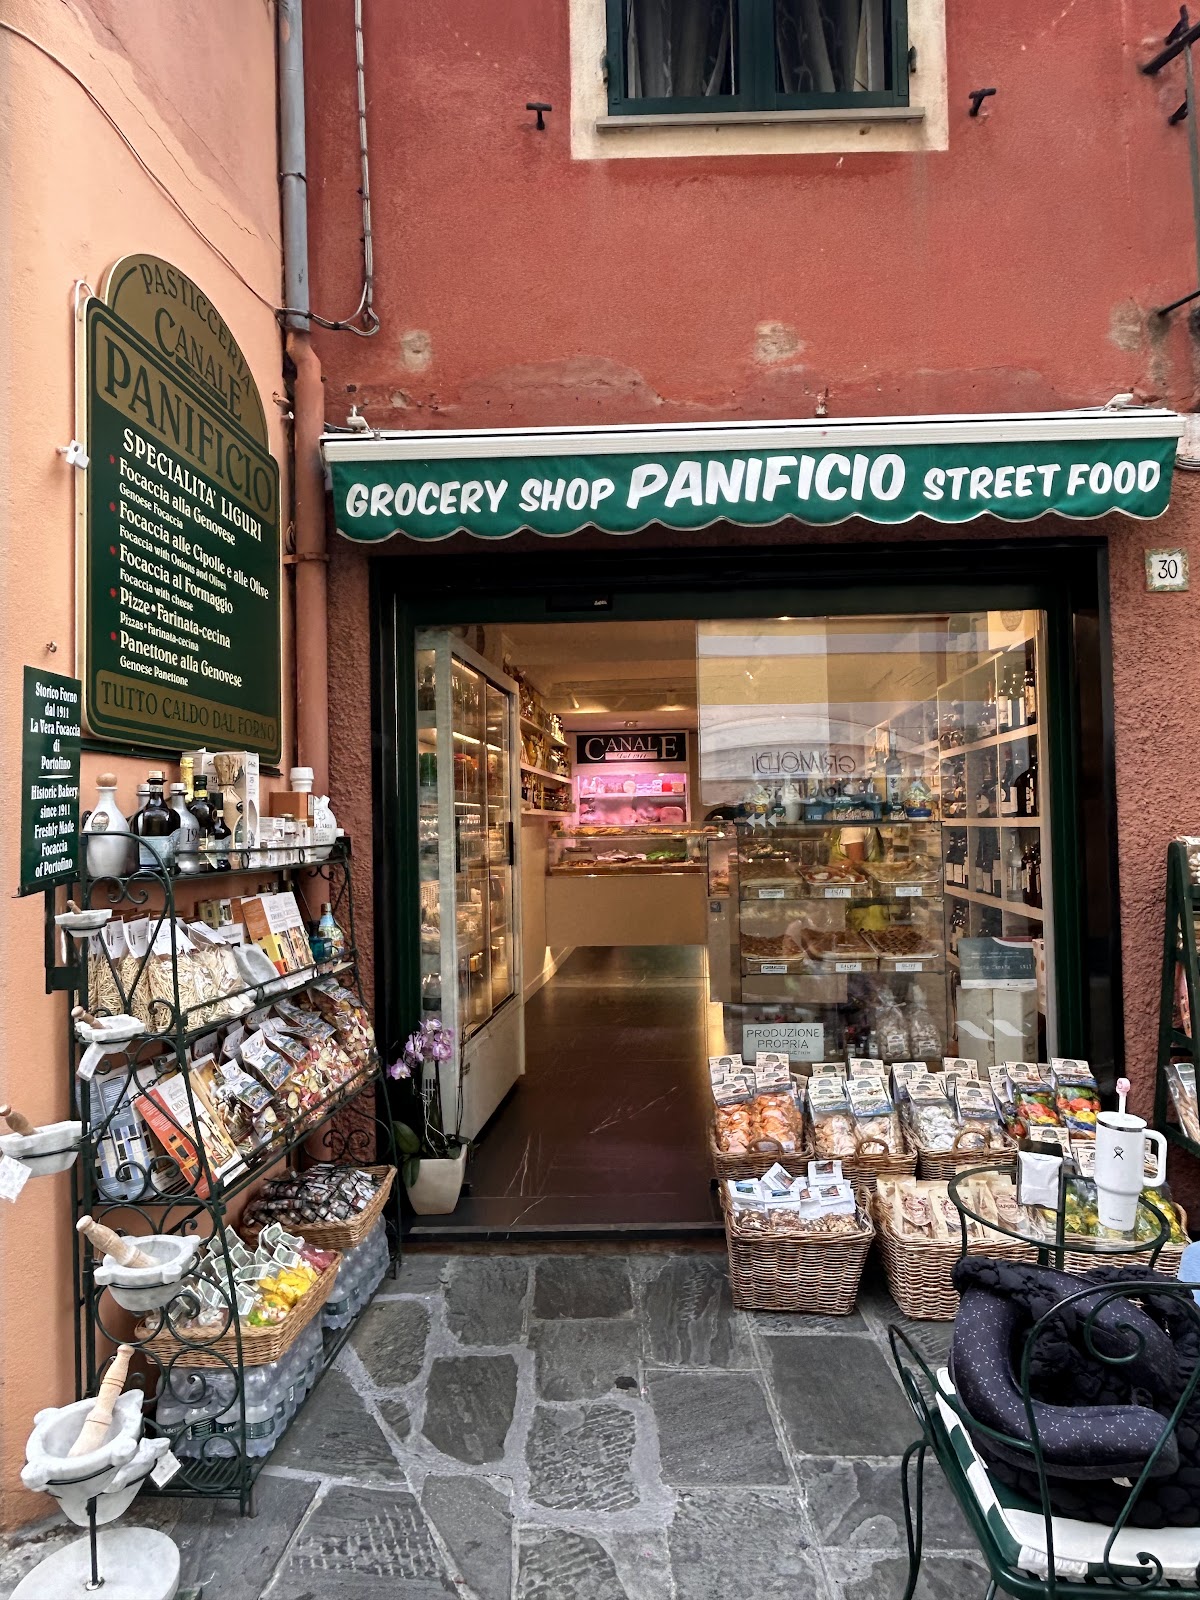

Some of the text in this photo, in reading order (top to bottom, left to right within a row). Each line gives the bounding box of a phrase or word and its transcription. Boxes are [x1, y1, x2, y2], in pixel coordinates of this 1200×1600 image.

[139, 263, 250, 397] PASTICCERIA
[154, 307, 242, 421] CANALE
[104, 336, 272, 513] PANIFICIO
[346, 453, 1161, 518] GROCERY SHOP PANIFICIO STREET FOOD
[119, 456, 236, 546] Focaccia alla Genovese
[119, 482, 184, 529] Genoese Focaccia
[221, 496, 262, 542] LIGURI
[119, 524, 227, 591] Focaccia with Onions and Olives
[120, 500, 269, 600] Focaccia alle Cipolle e alle Olive
[120, 543, 233, 614] Focaccia al Formaggio
[1157, 559, 1178, 579] 30
[120, 567, 194, 612] Focaccia with cheese
[119, 655, 189, 687] Genoese Panettone
[120, 629, 242, 688] Panettone alla Genovese
[35, 681, 78, 704] Storico Forno
[44, 701, 70, 719] dal 1911
[101, 680, 275, 742] TUTTO CALDO DAL FORNO
[30, 717, 81, 737] La Vera Focaccia
[53, 738, 60, 753] di
[585, 736, 679, 761] CANALE
[41, 755, 72, 771] Portofino
[31, 784, 79, 801] Historic Bakery
[40, 802, 71, 819] since 1911
[34, 820, 75, 840] Freshly Made
[41, 840, 68, 858] Focaccia
[35, 856, 73, 878] of Portofino
[746, 1028, 820, 1038] PRODUZIONE
[757, 1039, 809, 1049] PROPRIA
